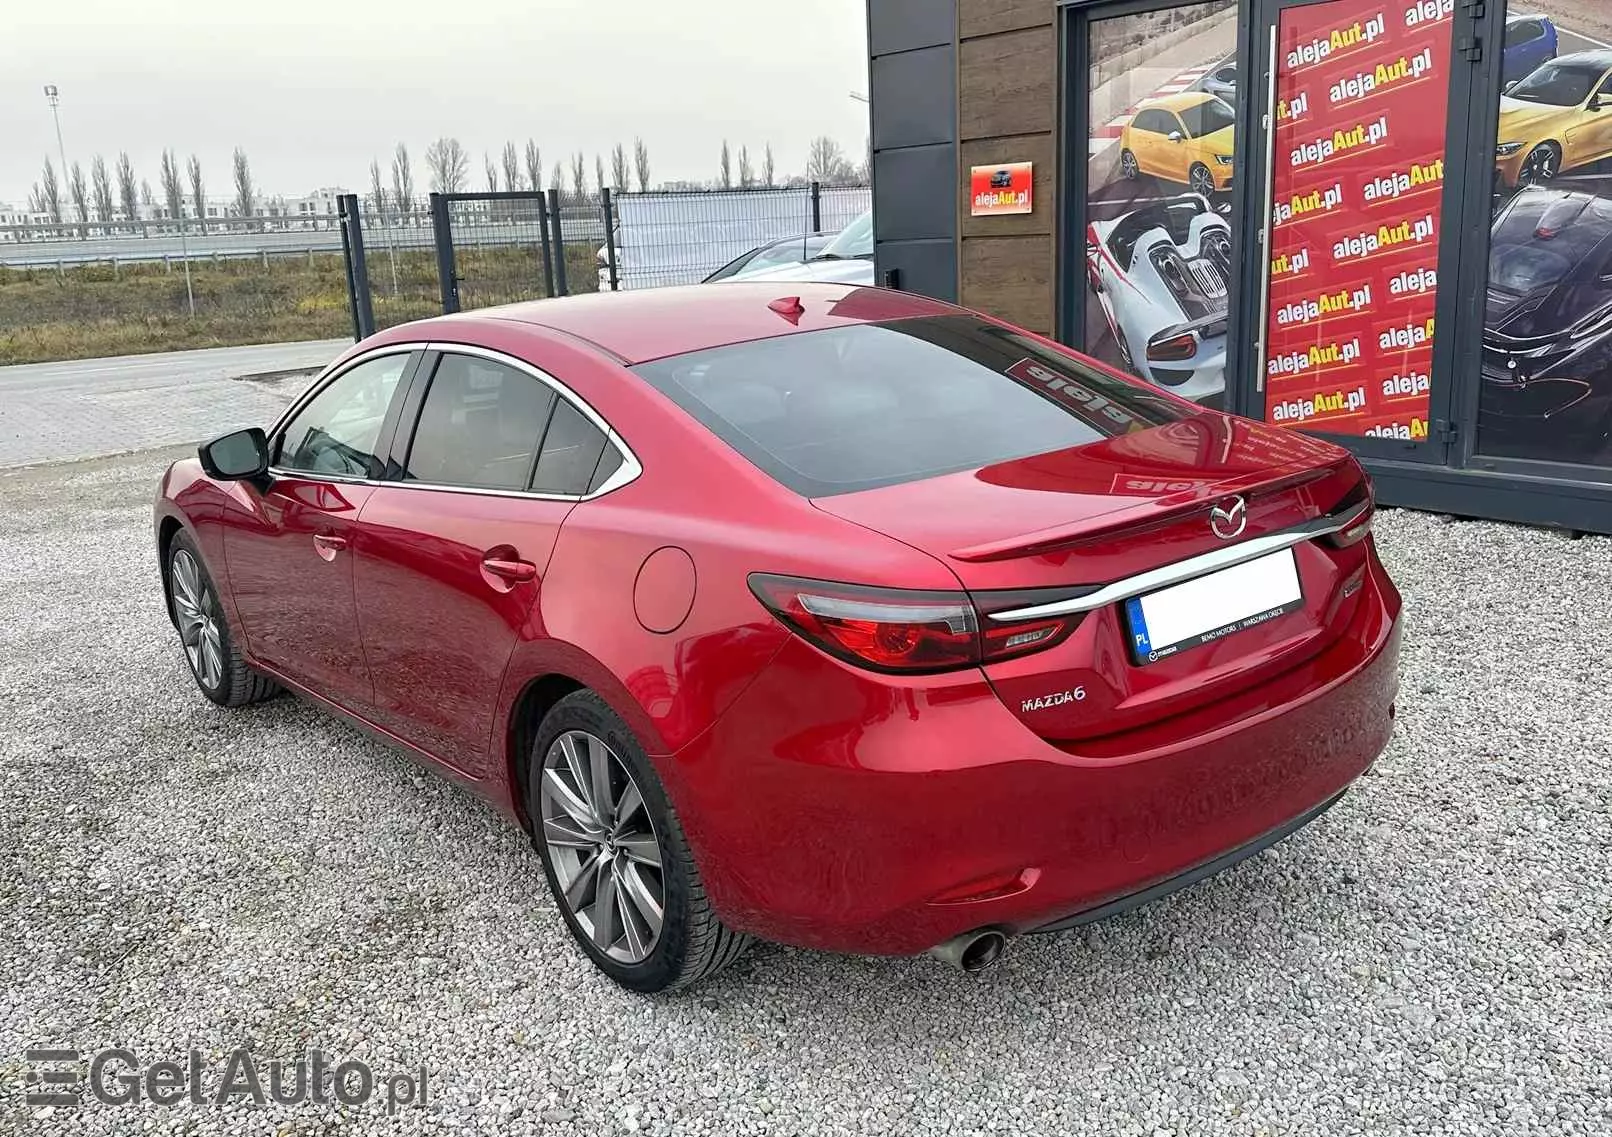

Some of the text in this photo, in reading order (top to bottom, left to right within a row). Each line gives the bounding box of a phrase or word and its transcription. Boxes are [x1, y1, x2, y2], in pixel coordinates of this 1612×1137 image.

[1287, 13, 1385, 68] alejaAut.pl
[1329, 48, 1432, 102] alejaAut.pl
[1290, 116, 1388, 167] alejaAut.pl
[975, 189, 1029, 208] alejaAut.pl
[1363, 159, 1443, 201] alejaAut
[1272, 183, 1342, 226] jaAut.pl
[1332, 214, 1434, 260] alejaAut.pl
[1390, 268, 1437, 294] aleja
[1276, 285, 1371, 324] alejaAut.pl
[1268, 338, 1361, 374] alejaAut.pl
[1382, 367, 1432, 396] aleja
[1272, 387, 1366, 421] alejaAut.pl
[1136, 634, 1149, 647] PL
[1216, 624, 1237, 637] MOTORS
